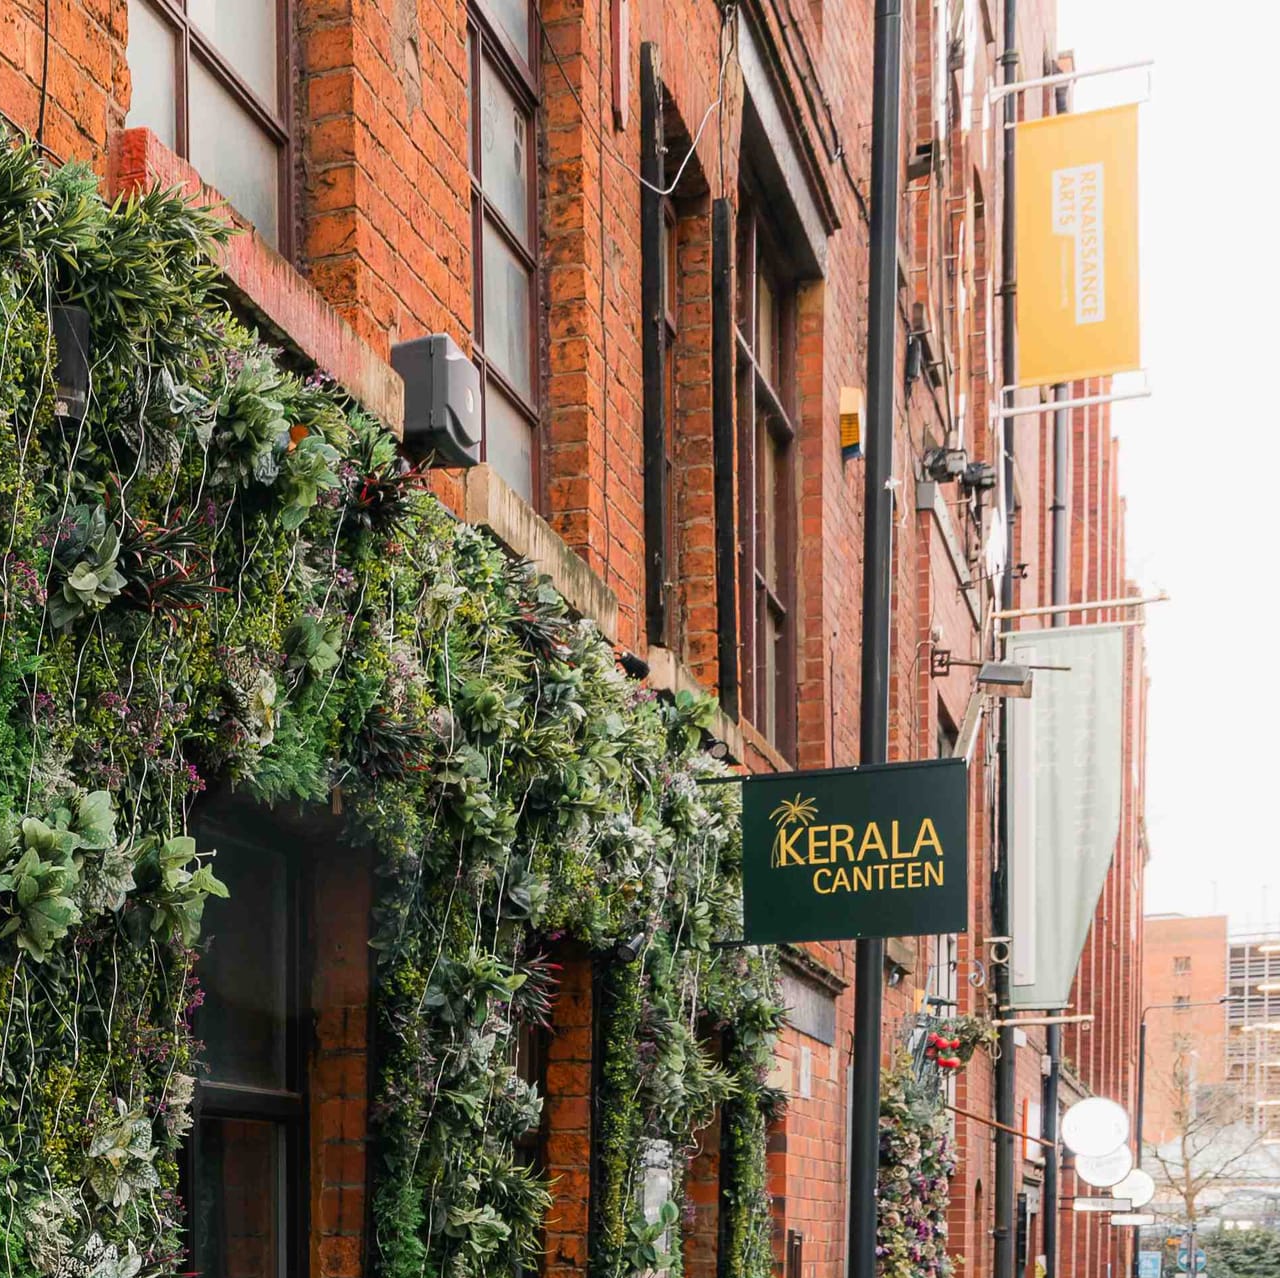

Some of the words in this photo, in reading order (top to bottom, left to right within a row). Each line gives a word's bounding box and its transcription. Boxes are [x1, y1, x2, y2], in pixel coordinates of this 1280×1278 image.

[1059, 175, 1075, 225] ARTS
[1080, 171, 1098, 317] RENAISSANCE
[780, 818, 944, 867] KERALA
[813, 861, 944, 895] CANTEEN
